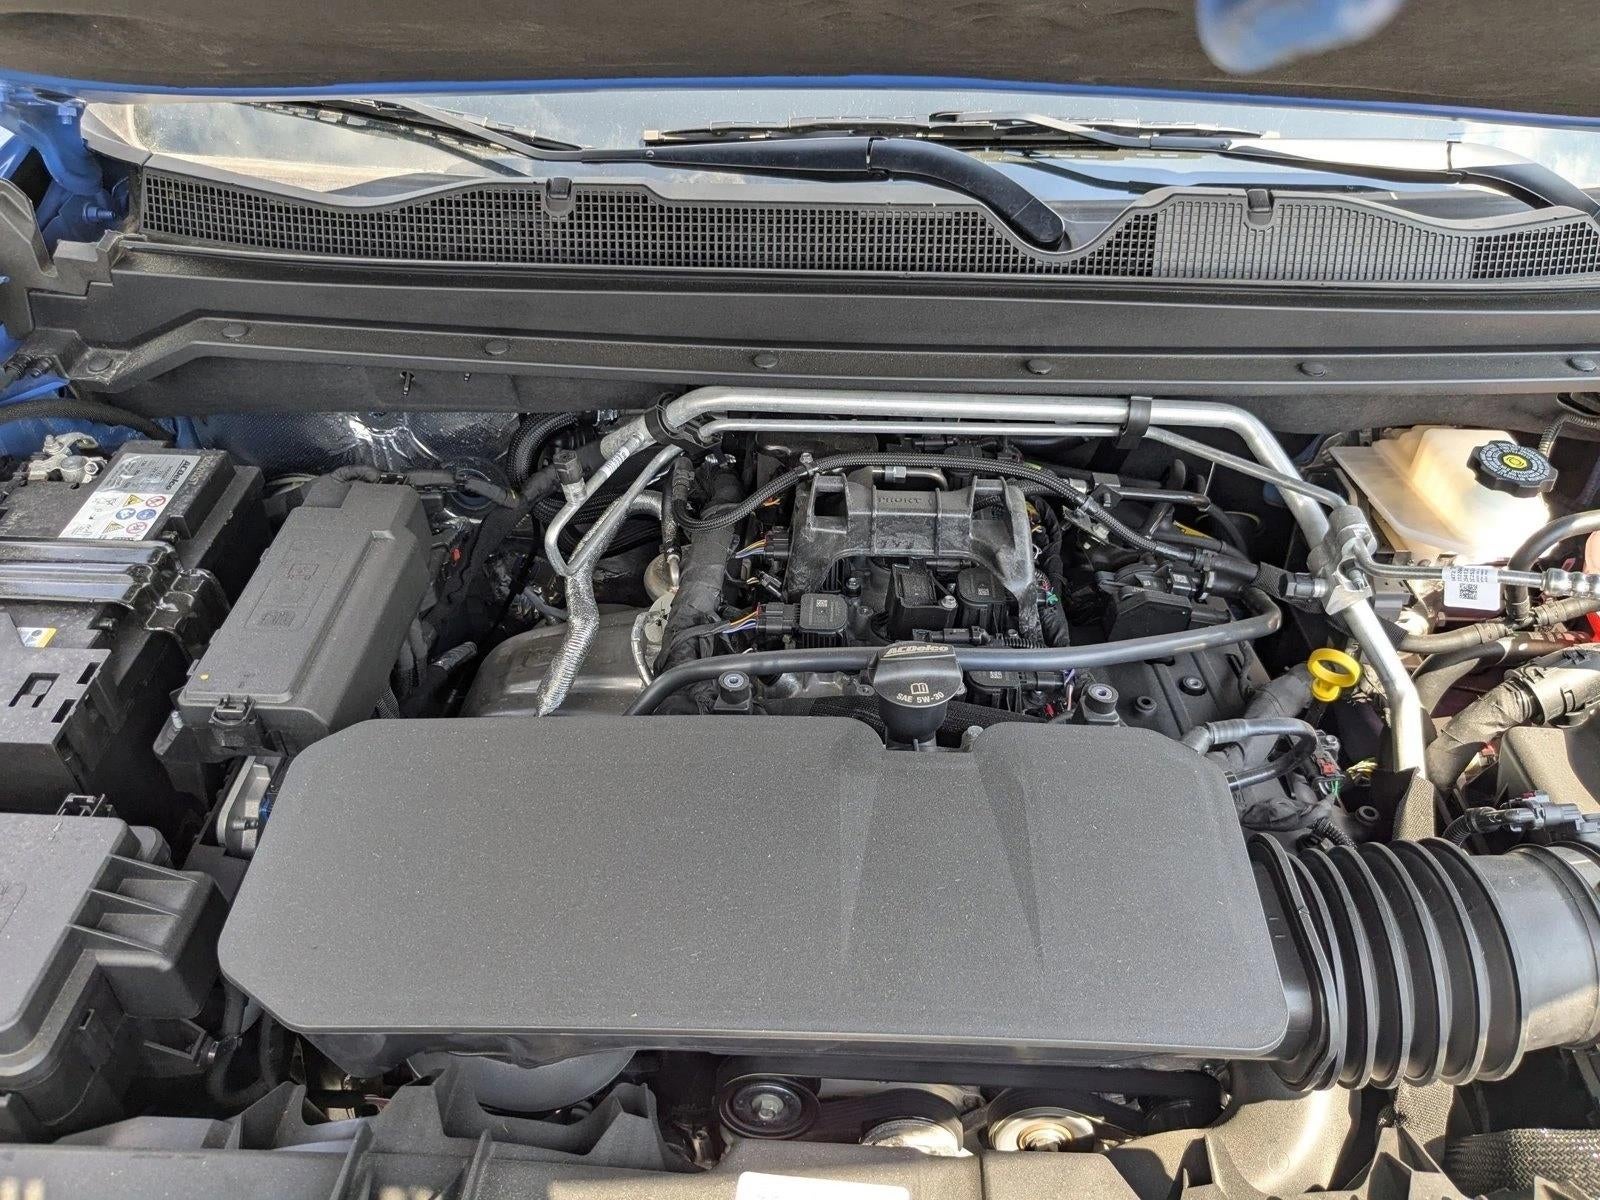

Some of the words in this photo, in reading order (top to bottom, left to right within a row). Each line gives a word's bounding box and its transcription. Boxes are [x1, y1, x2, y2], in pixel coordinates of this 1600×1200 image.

[166, 460, 191, 491] ACDelco
[884, 644, 949, 657] ACDelco
[896, 692, 913, 704] SAE
[916, 691, 945, 704] 5W-30
